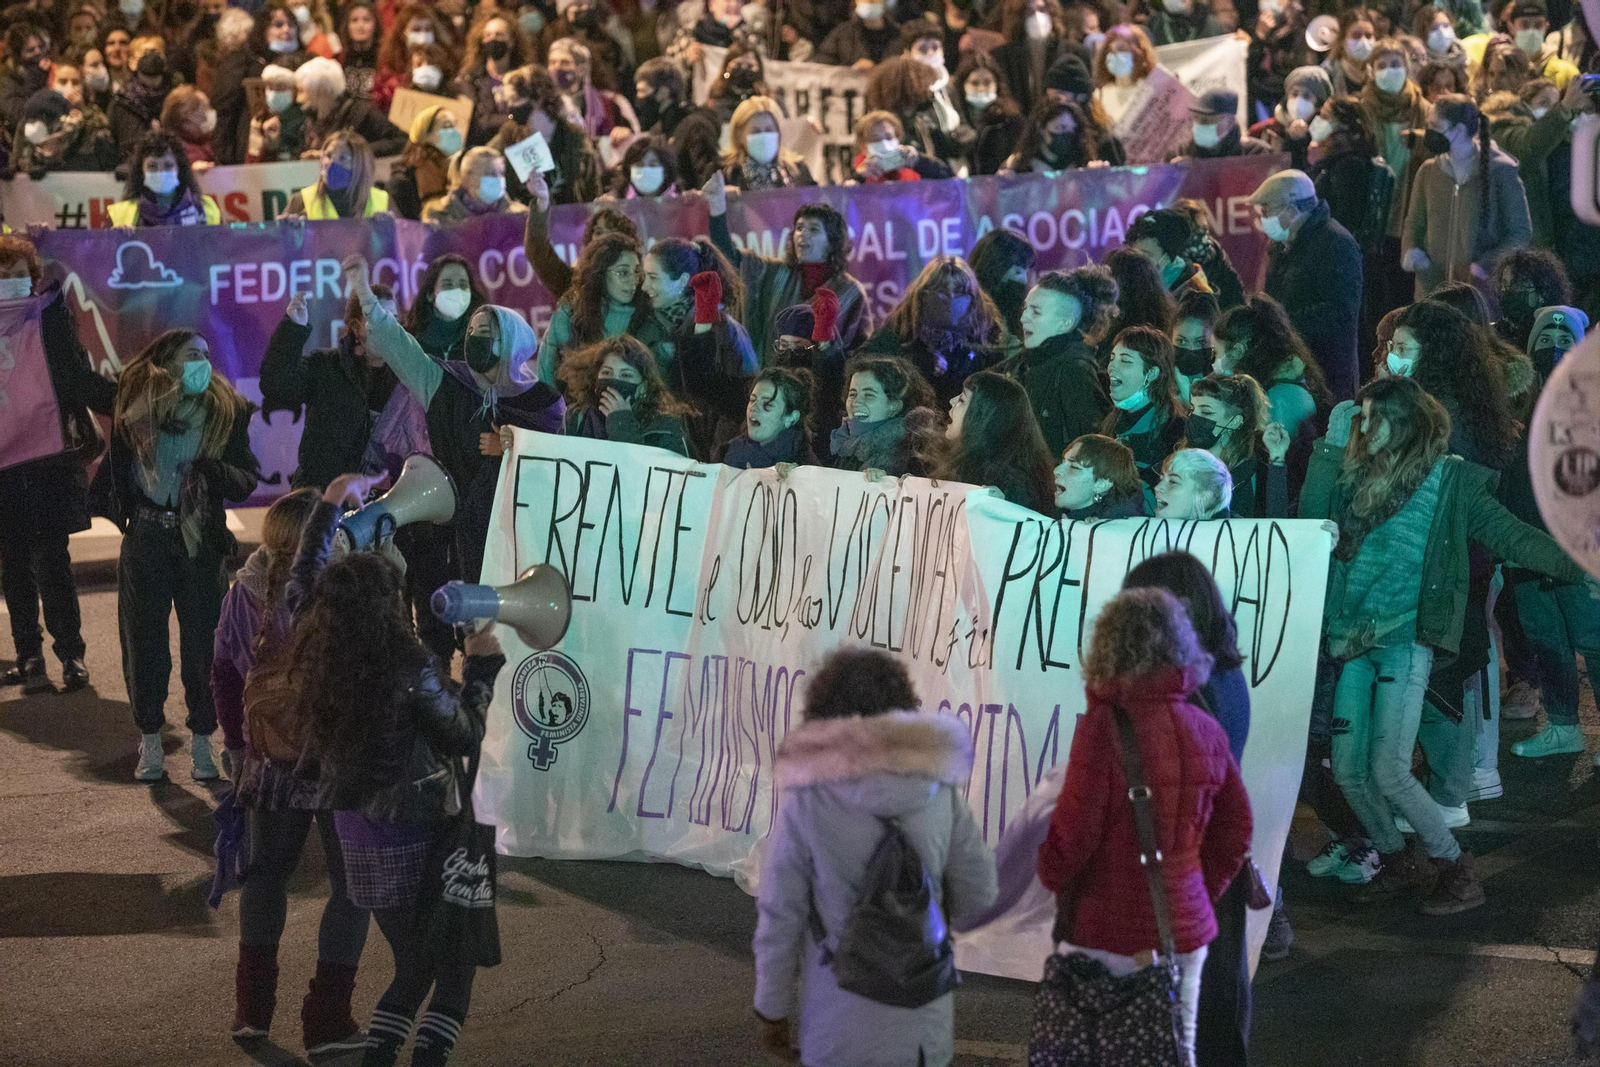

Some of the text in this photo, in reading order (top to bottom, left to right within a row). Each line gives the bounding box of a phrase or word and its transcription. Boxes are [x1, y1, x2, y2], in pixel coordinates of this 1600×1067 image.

[917, 218, 963, 258] DE
[512, 454, 707, 618] FRENTE
[826, 486, 967, 664] VIOLENCIAS
[516, 659, 587, 738] ASAMBLEA FEMINISTA UNITARIA
